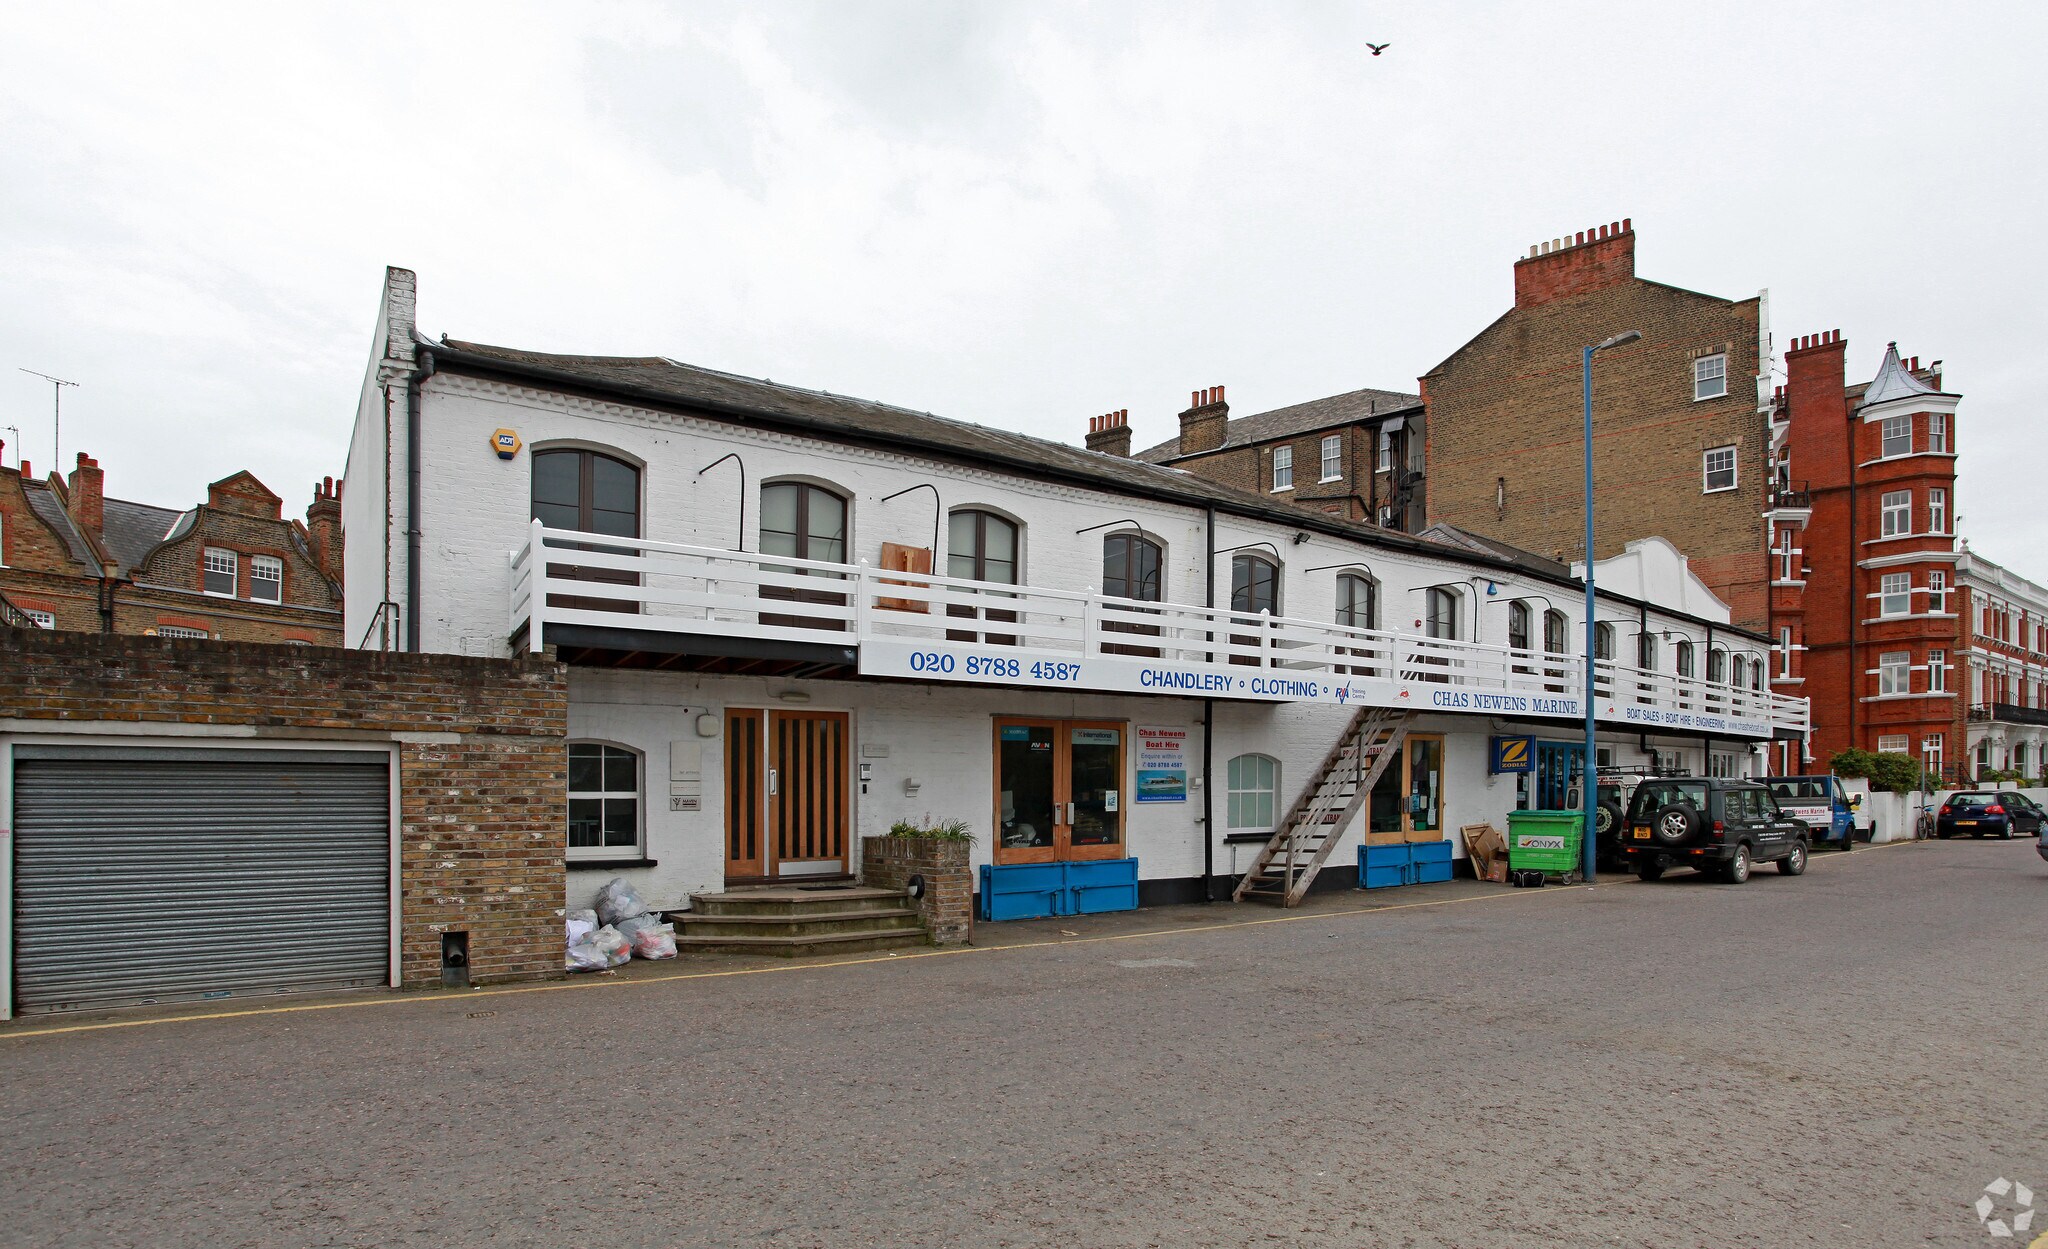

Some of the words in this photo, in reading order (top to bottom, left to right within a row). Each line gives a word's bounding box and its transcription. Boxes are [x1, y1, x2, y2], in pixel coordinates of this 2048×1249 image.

[499, 436, 514, 445] ADT
[910, 652, 955, 673] 020
[966, 656, 1020, 678] 8788
[1030, 661, 1081, 681] 4587
[1140, 669, 1233, 692] CHANDLERY
[1251, 677, 1318, 697] CLOTHING
[1351, 687, 1366, 695] Training
[1433, 690, 1469, 708] CHAS
[1473, 693, 1527, 711] NEWENS
[1532, 698, 1578, 714] MARINE
[1626, 708, 1641, 719] BOAT
[1642, 709, 1659, 722] SALES
[1665, 712, 1679, 724] BOAT
[1680, 714, 1691, 726] HIRE
[1695, 716, 1726, 730] ENGINEERING
[1158, 730, 1186, 738] Newens
[1145, 740, 1163, 748] Boat
[1140, 752, 1160, 760] Enquire
[1531, 840, 1561, 849] ONYX
